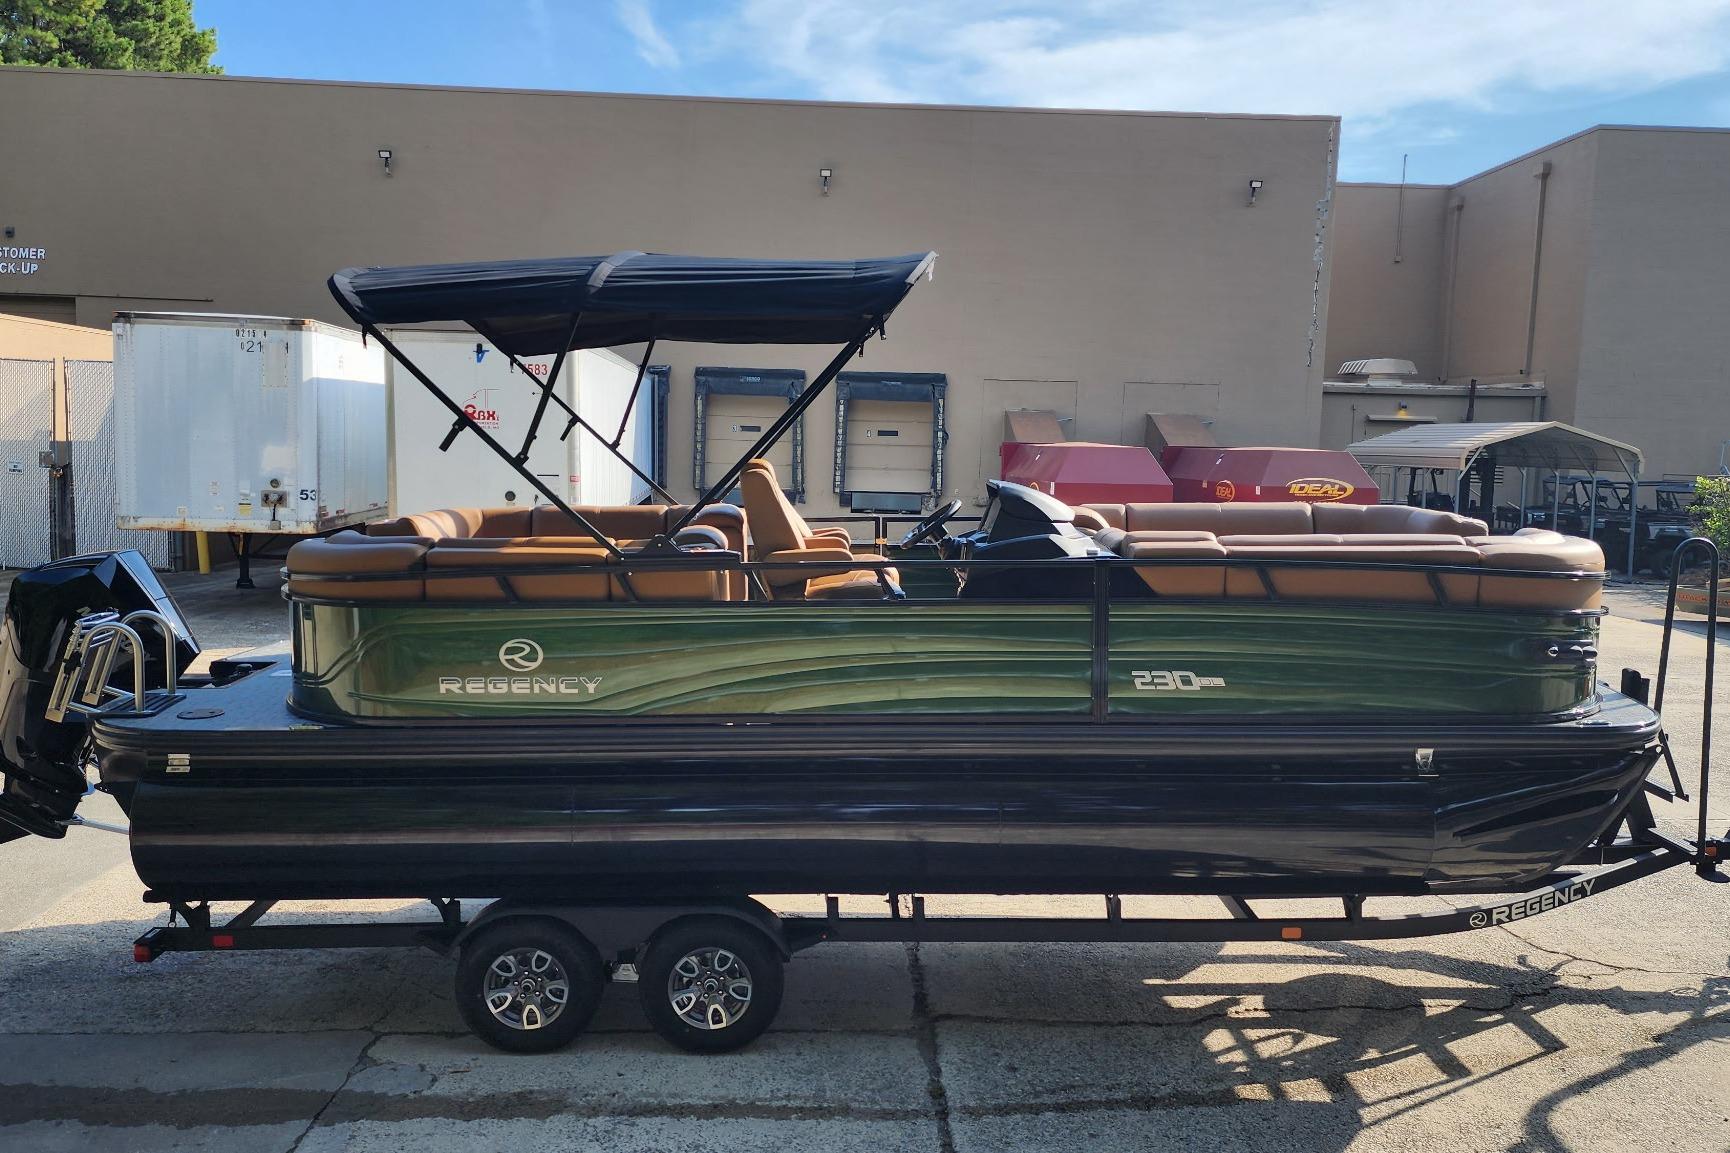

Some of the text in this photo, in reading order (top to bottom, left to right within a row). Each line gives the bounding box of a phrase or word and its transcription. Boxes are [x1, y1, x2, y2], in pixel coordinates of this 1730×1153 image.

[299, 489, 317, 501] 53
[1289, 483, 1345, 495] IDEAL
[438, 676, 603, 694] REGENCY
[1492, 878, 1597, 926] REGENCY
